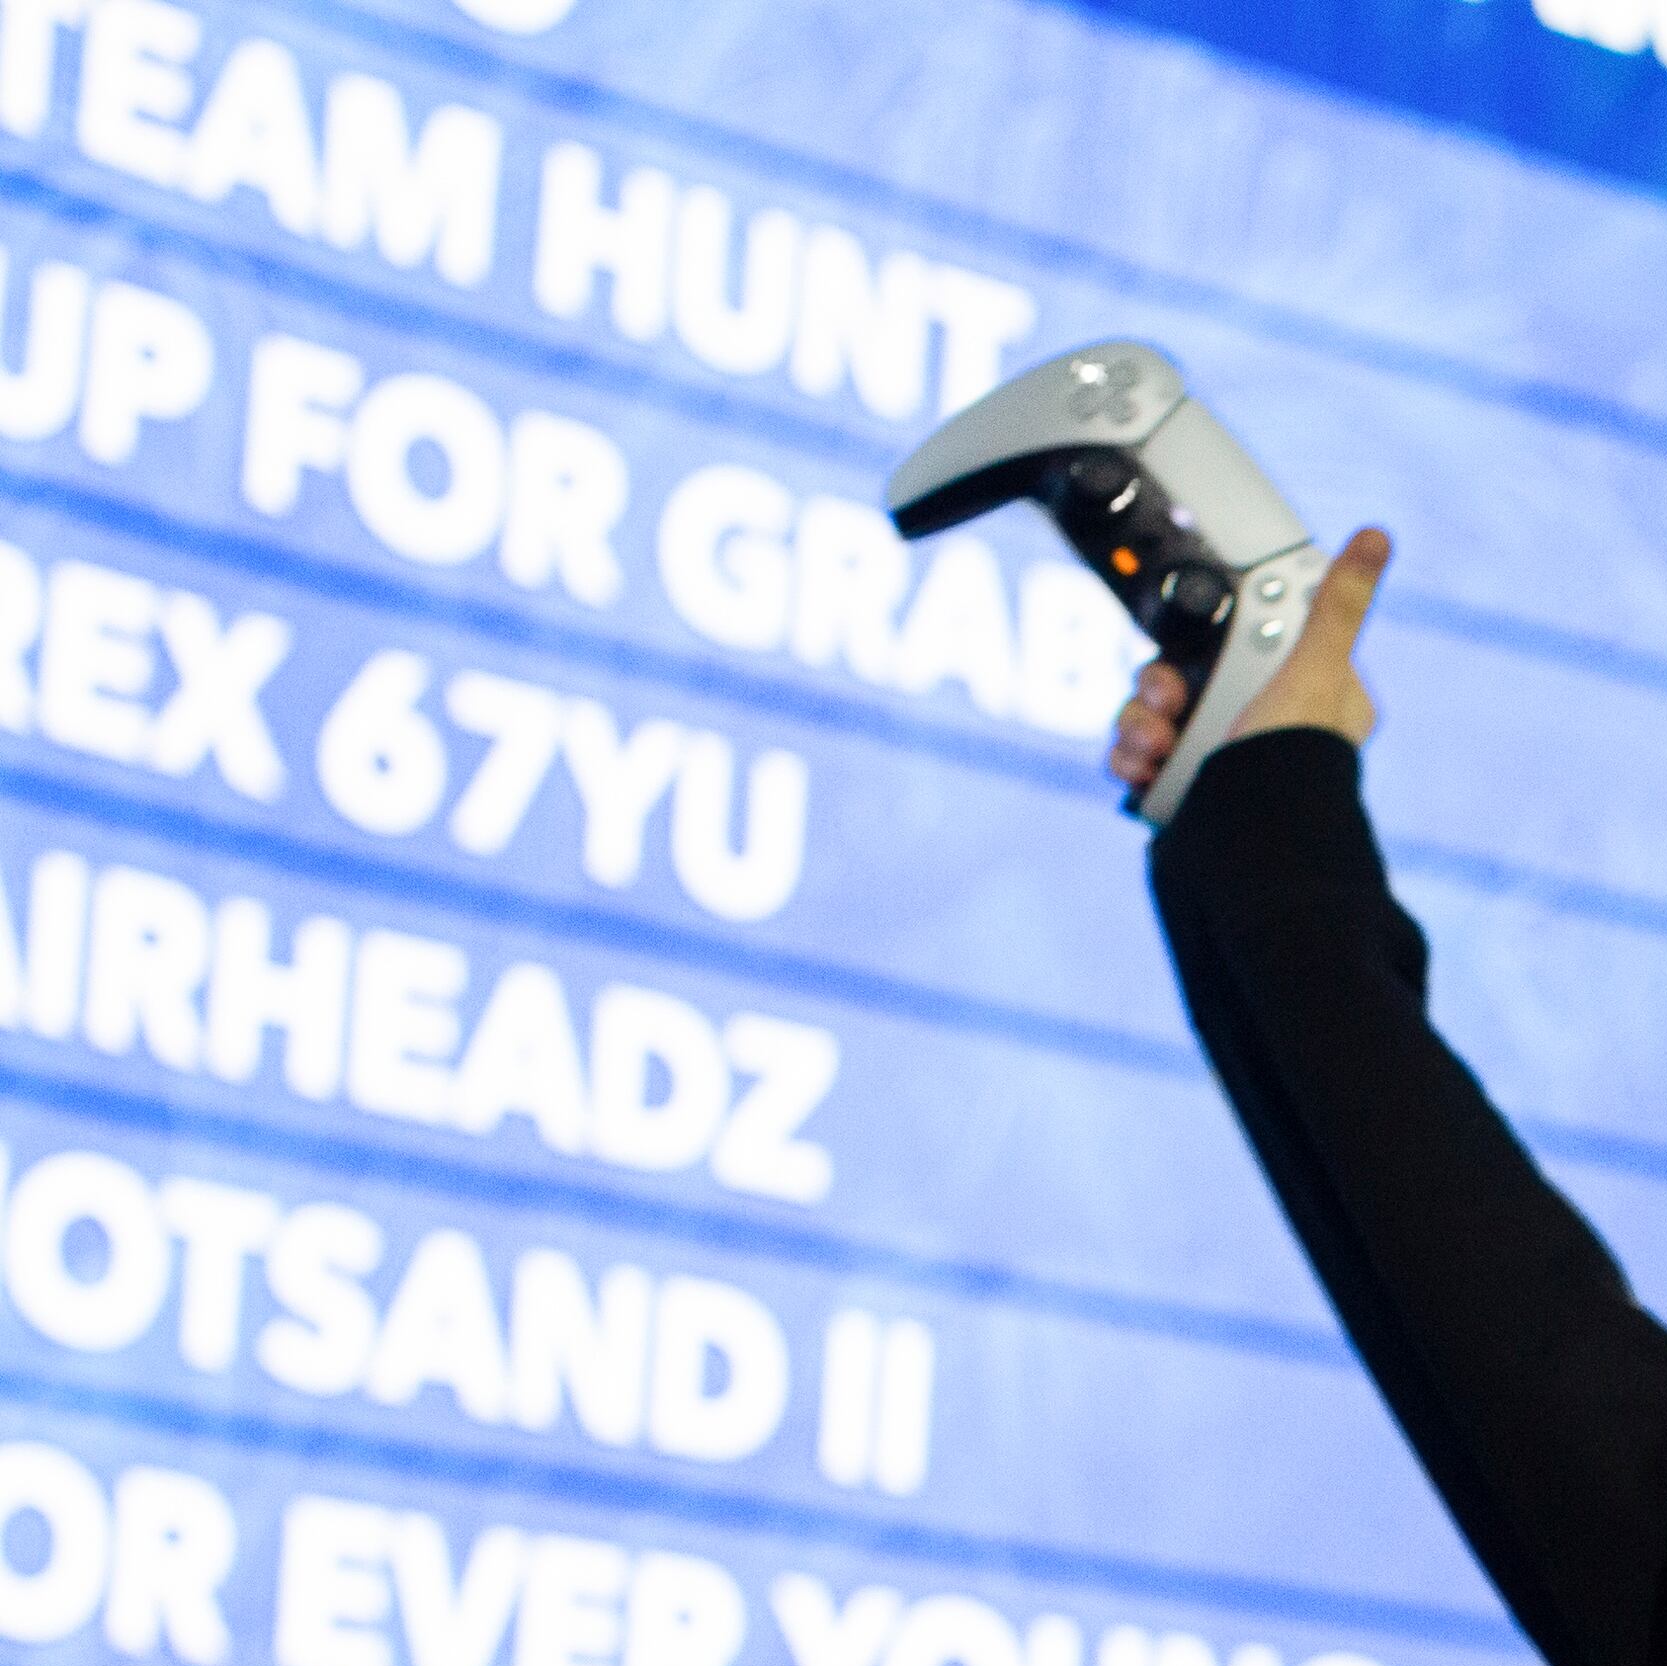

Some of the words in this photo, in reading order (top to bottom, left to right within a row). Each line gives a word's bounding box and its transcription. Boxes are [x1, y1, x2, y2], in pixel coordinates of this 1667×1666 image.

[0, 0, 499, 283] TEAM
[534, 144, 1033, 419] HUNT
[0, 264, 212, 462] UP
[245, 336, 628, 605] FOR
[657, 464, 1158, 738] GRAB
[321, 652, 807, 920] 67YU
[0, 852, 838, 1203] IRHEADZ
[0, 1149, 788, 1460] OTSAND
